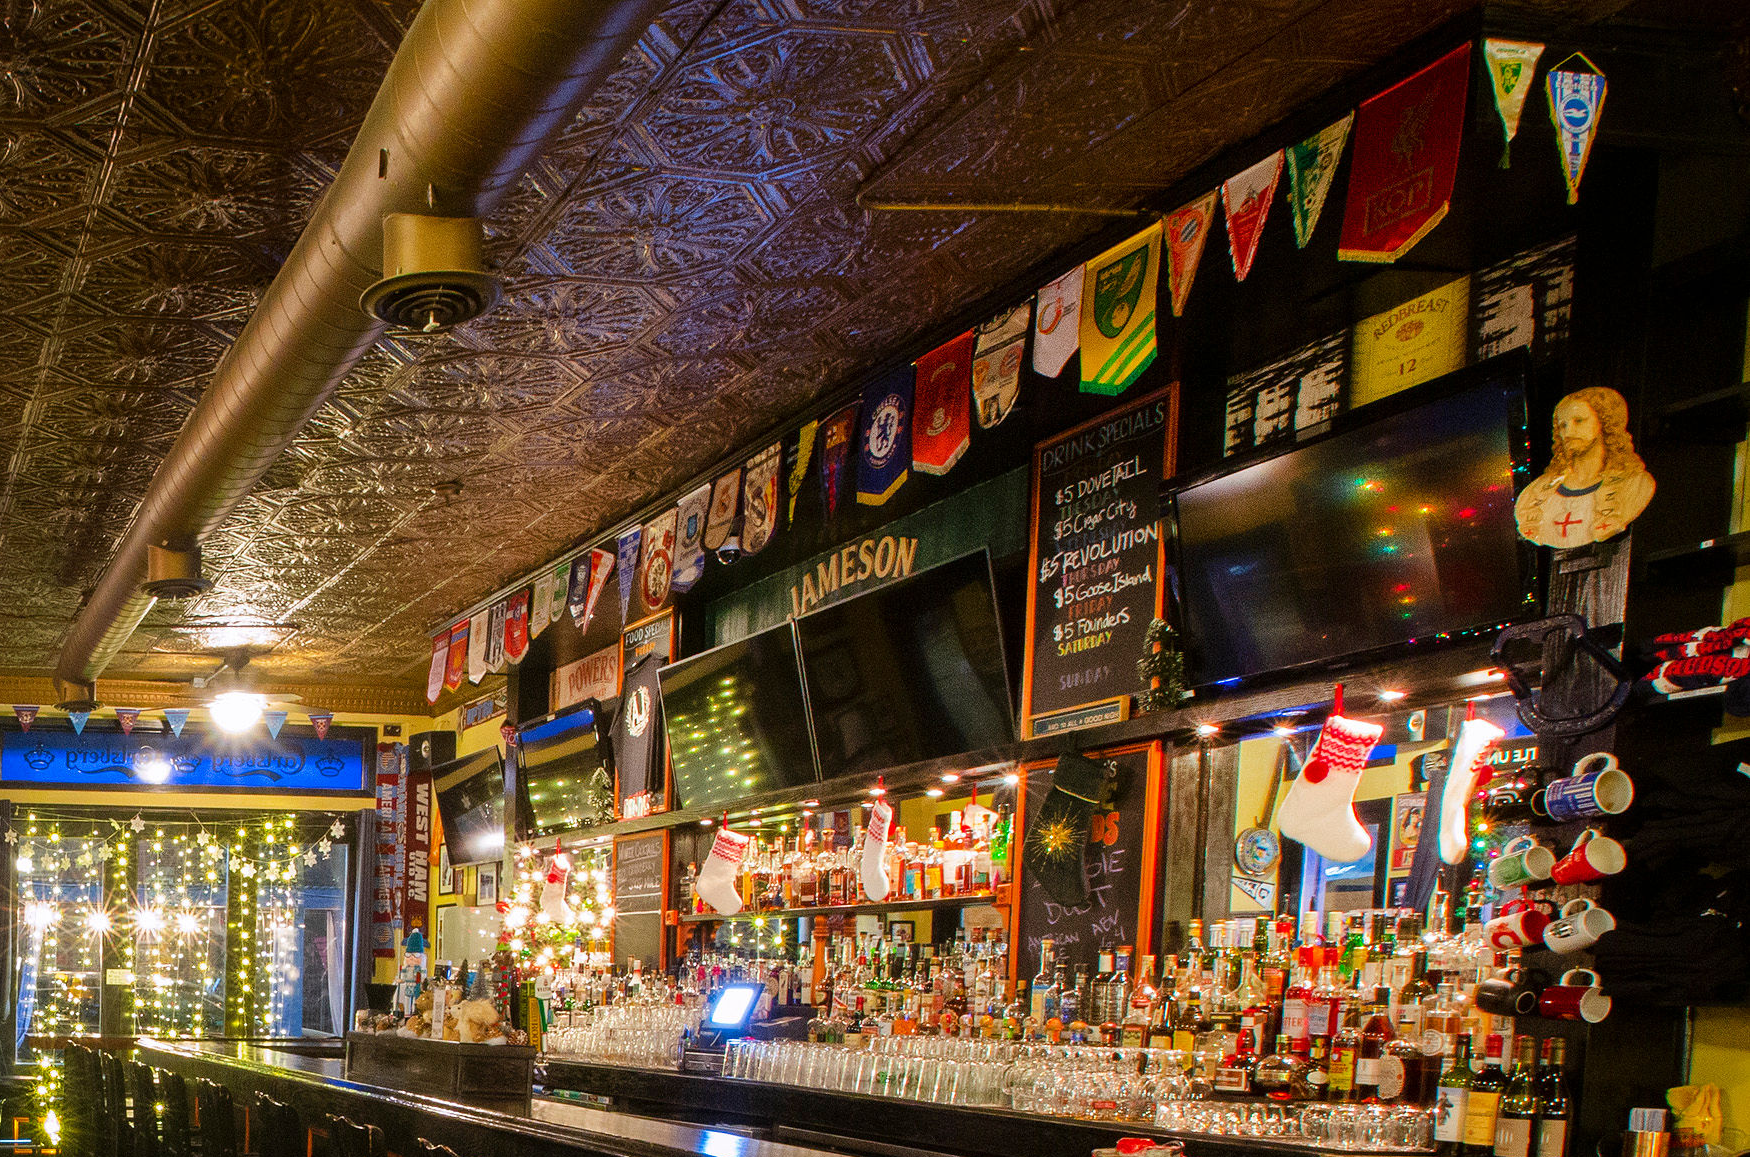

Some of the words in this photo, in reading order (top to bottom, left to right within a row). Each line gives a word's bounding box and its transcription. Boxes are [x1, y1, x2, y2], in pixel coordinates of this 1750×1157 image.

[1373, 298, 1450, 340] REDBREAST
[1399, 359, 1417, 375] 12
[1042, 430, 1095, 473] DRINK
[1097, 401, 1165, 449] SPECIALS
[1053, 517, 1073, 542] $5
[1062, 519, 1159, 575] REVOLUTION
[786, 535, 918, 619] JAMESON
[1053, 584, 1075, 609] $5
[1075, 581, 1113, 602] Goose
[1111, 564, 1153, 594] Island
[625, 628, 644, 645] FOOD
[1053, 622, 1074, 642] $5
[1076, 607, 1131, 635] Founders
[1057, 630, 1113, 657] SATURDAY
[568, 655, 615, 697] POWERS
[381, 782, 393, 841] AMERICAN
[416, 783, 429, 844] WEST
[378, 858, 391, 914] HAMMERS
[408, 880, 416, 900] F.C.
[415, 850, 428, 902] HAM
